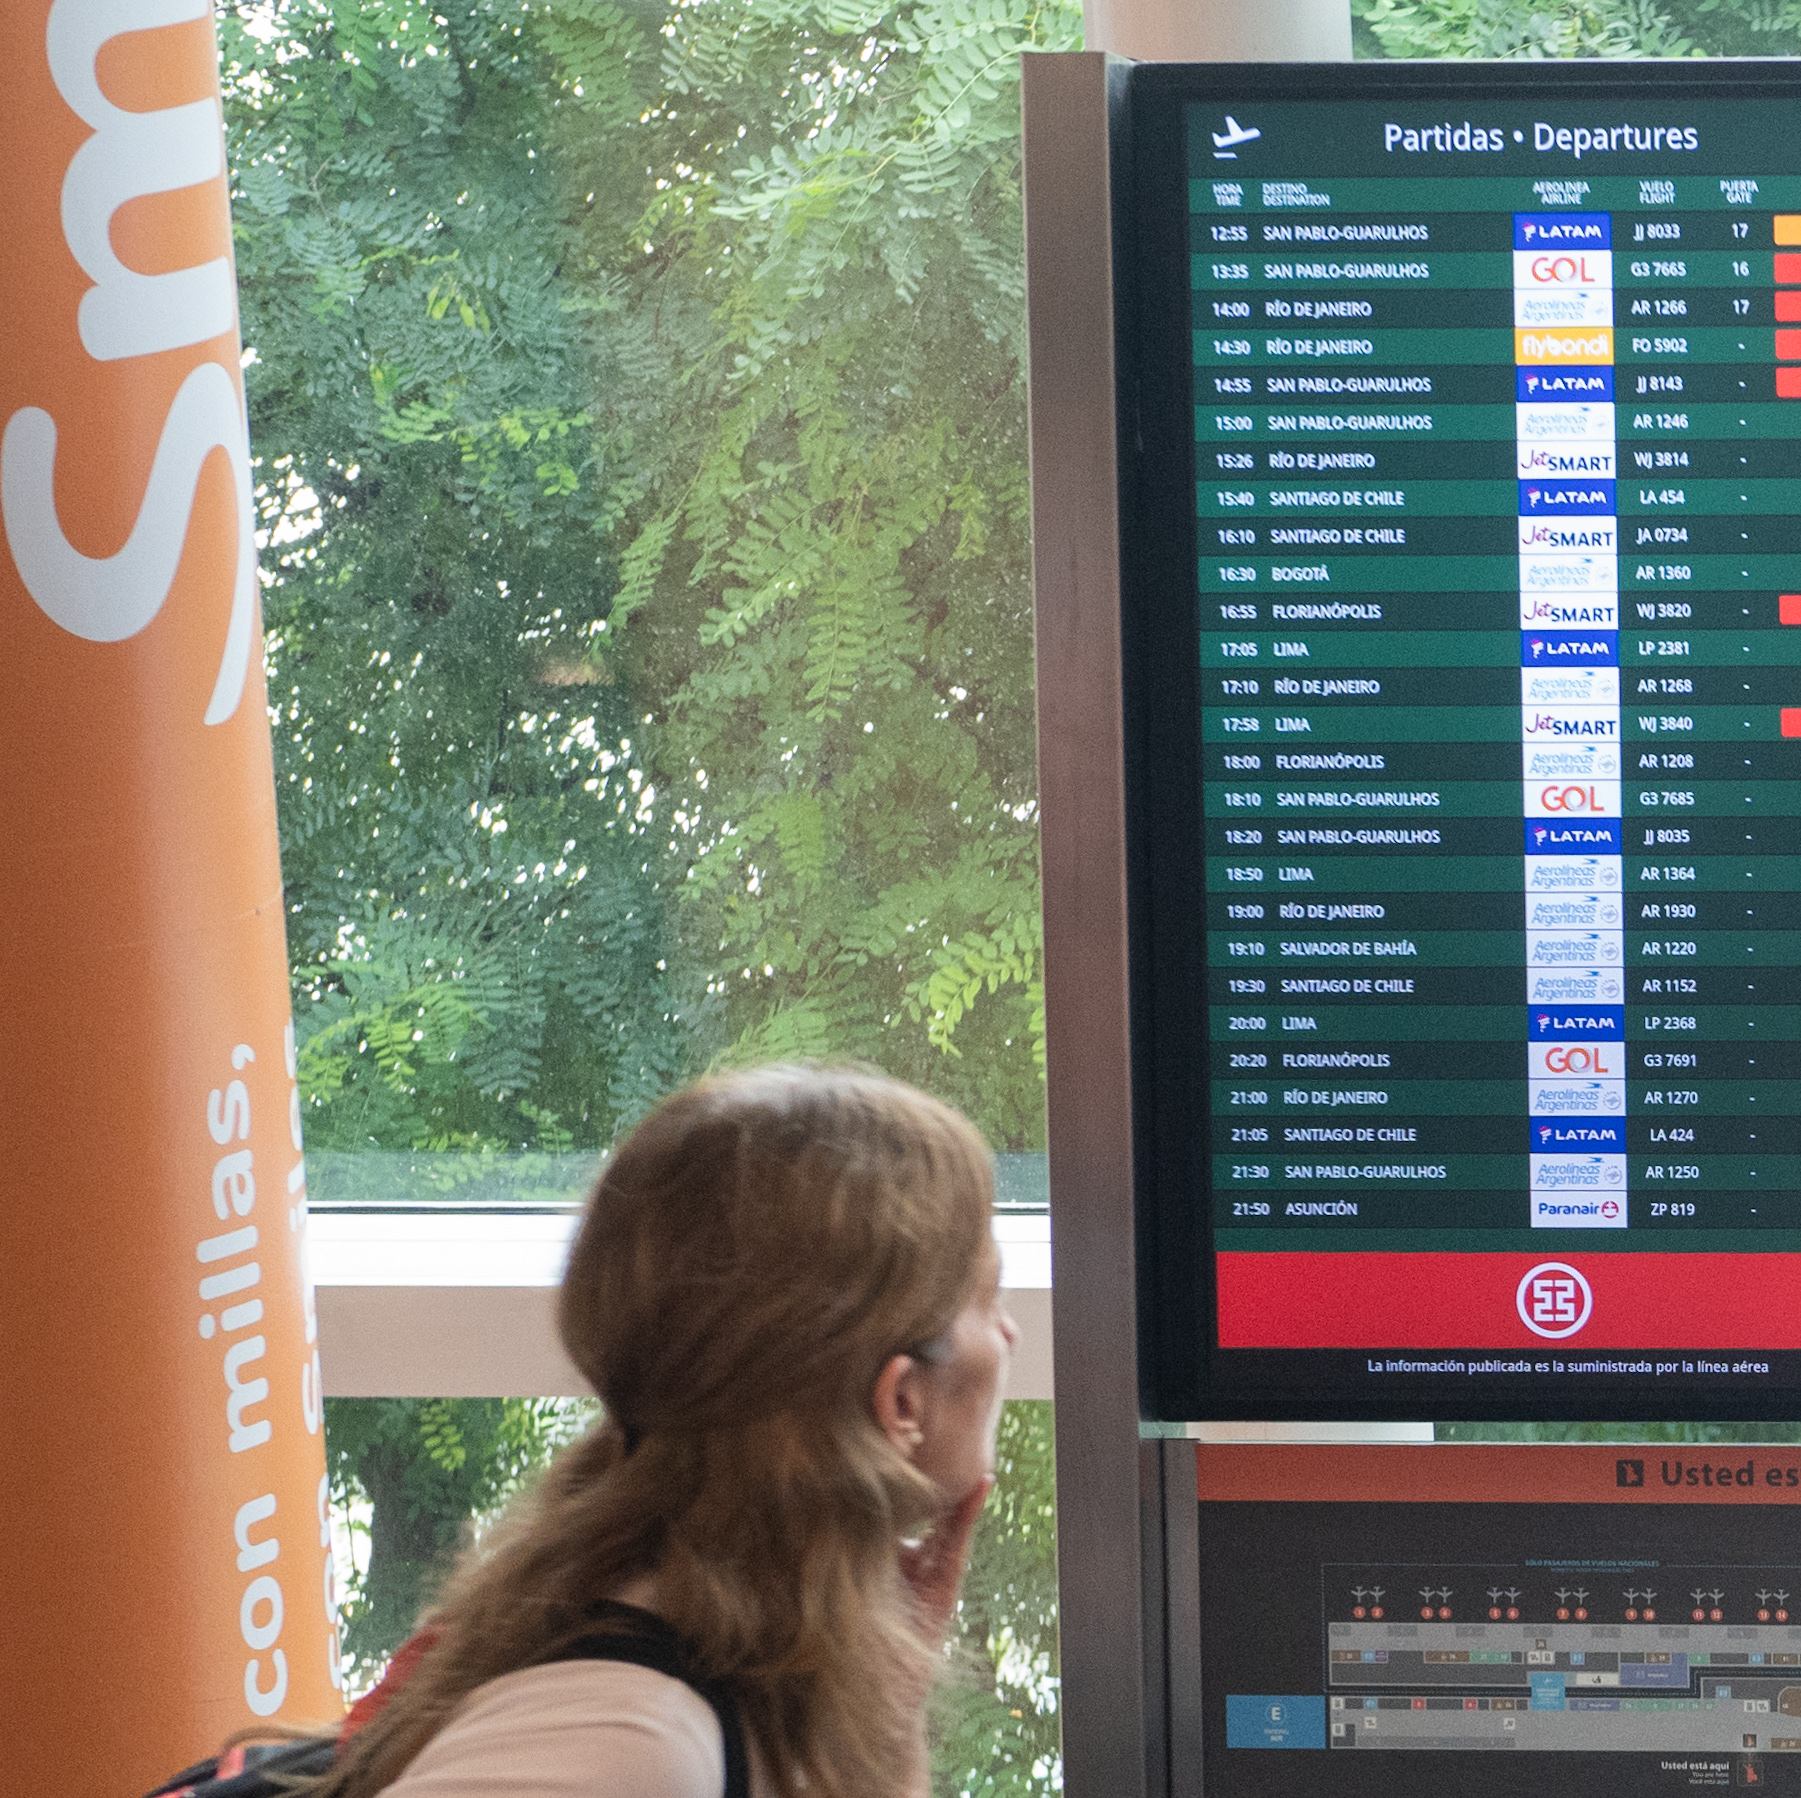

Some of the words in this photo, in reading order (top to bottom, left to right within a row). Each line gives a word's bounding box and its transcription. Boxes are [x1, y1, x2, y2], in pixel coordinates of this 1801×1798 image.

[1385, 121, 1504, 152] Partidas
[1534, 122, 1698, 159] Departures
[1210, 225, 1249, 242] 12:55
[1263, 225, 1293, 241] SAN
[1294, 224, 1429, 241] PABLO-GUARULHOS
[1538, 225, 1602, 239] LATAM
[1646, 223, 1681, 239] 8033
[1731, 222, 1749, 239] 17
[1211, 263, 1249, 279] 13:35
[1264, 263, 1294, 279] SAN
[1295, 262, 1430, 279] PABLO-GUARULHOS
[1531, 256, 1596, 283] GOL
[1630, 261, 1651, 277] G3
[1652, 261, 1687, 277] 7665
[1732, 261, 1750, 277] 16
[1232, 1202, 1271, 1216] 21:50
[1285, 1199, 1358, 1216] ASUNCIÓN
[1538, 1202, 1600, 1215] Paranair
[1650, 1202, 1668, 1216] ZP
[1670, 1202, 1696, 1216] 819
[197, 1042, 272, 1454] millas,
[1661, 1460, 1755, 1487] Usted
[234, 1493, 288, 1716] con
